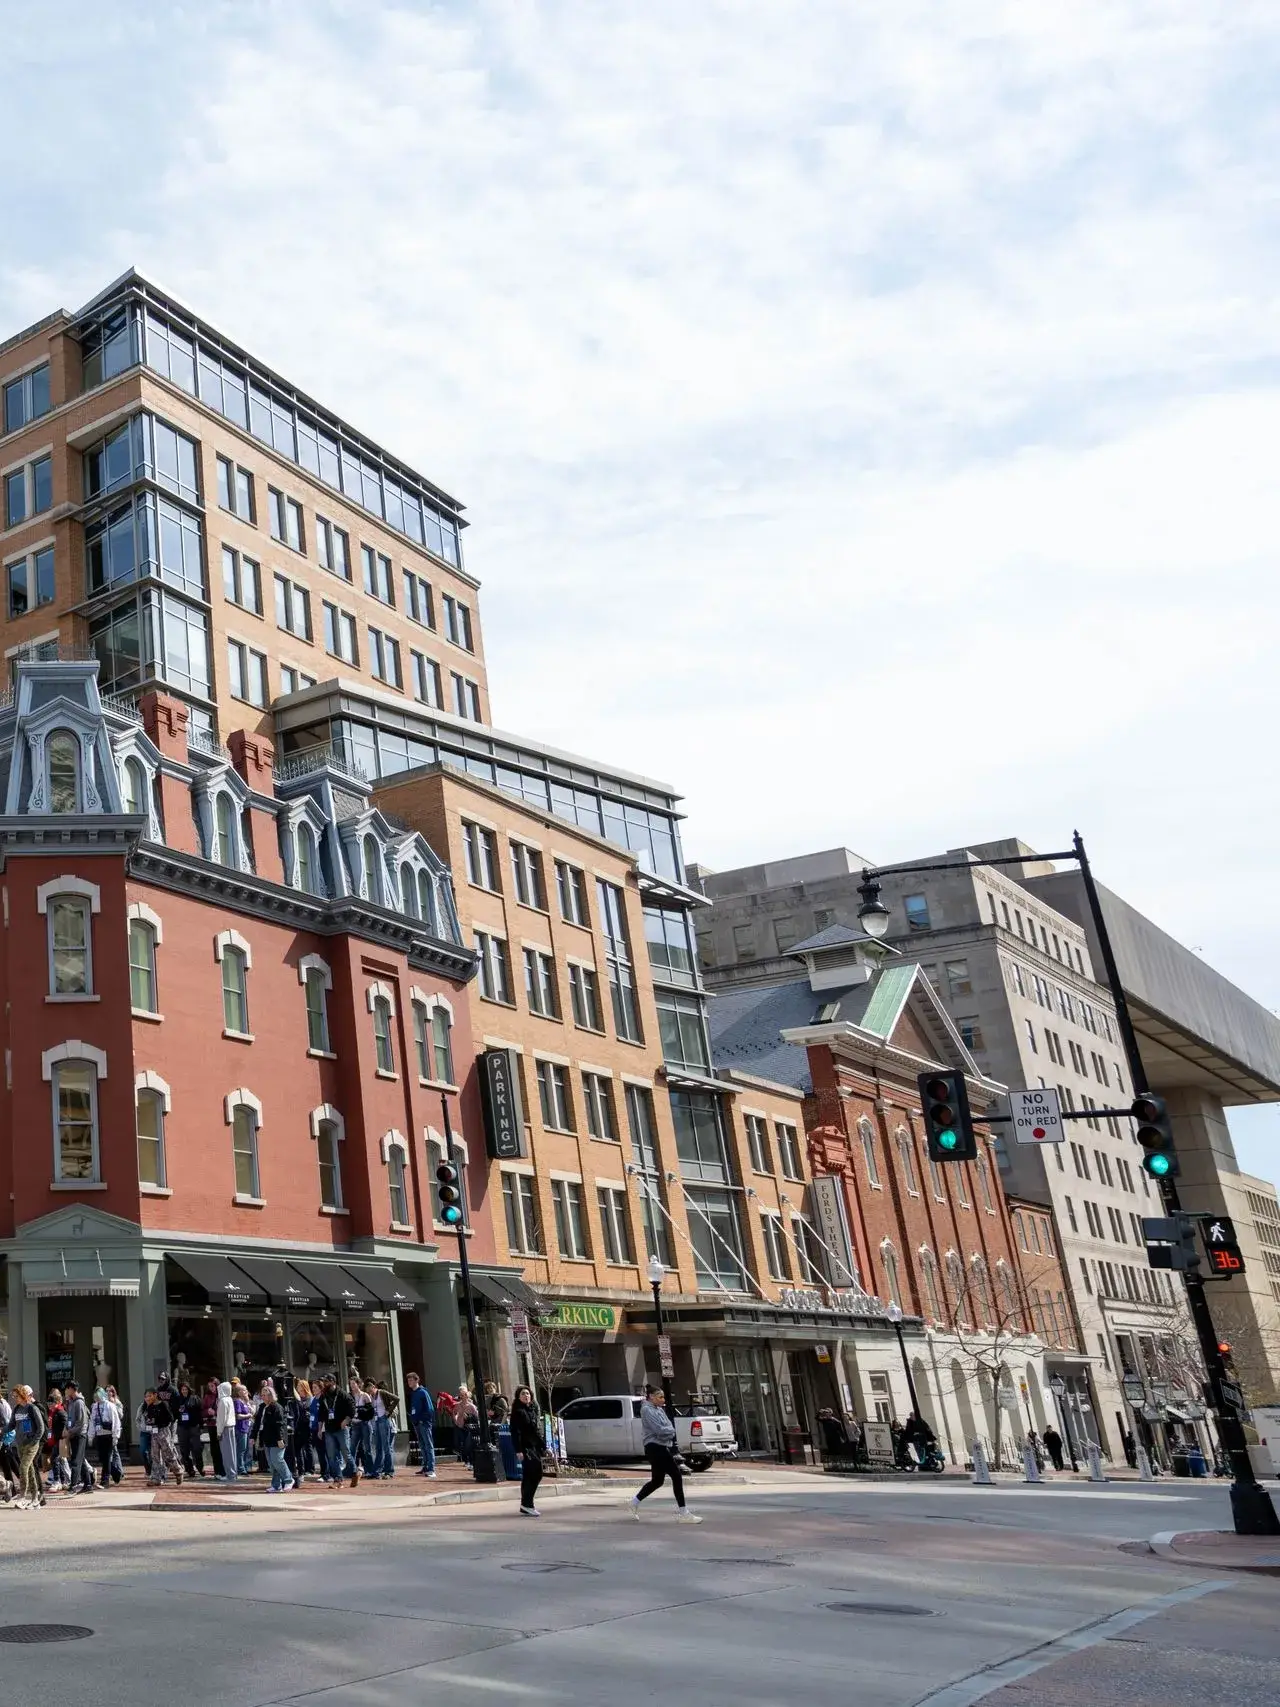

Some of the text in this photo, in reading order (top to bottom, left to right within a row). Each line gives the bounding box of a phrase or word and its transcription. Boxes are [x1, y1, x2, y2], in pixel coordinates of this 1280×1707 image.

[493, 1058, 511, 1142] PARKING
[1022, 1093, 1044, 1105] NO
[1021, 1106, 1050, 1115] TURN
[1017, 1116, 1057, 1127] ON RED
[1213, 1250, 1240, 1268] 36
